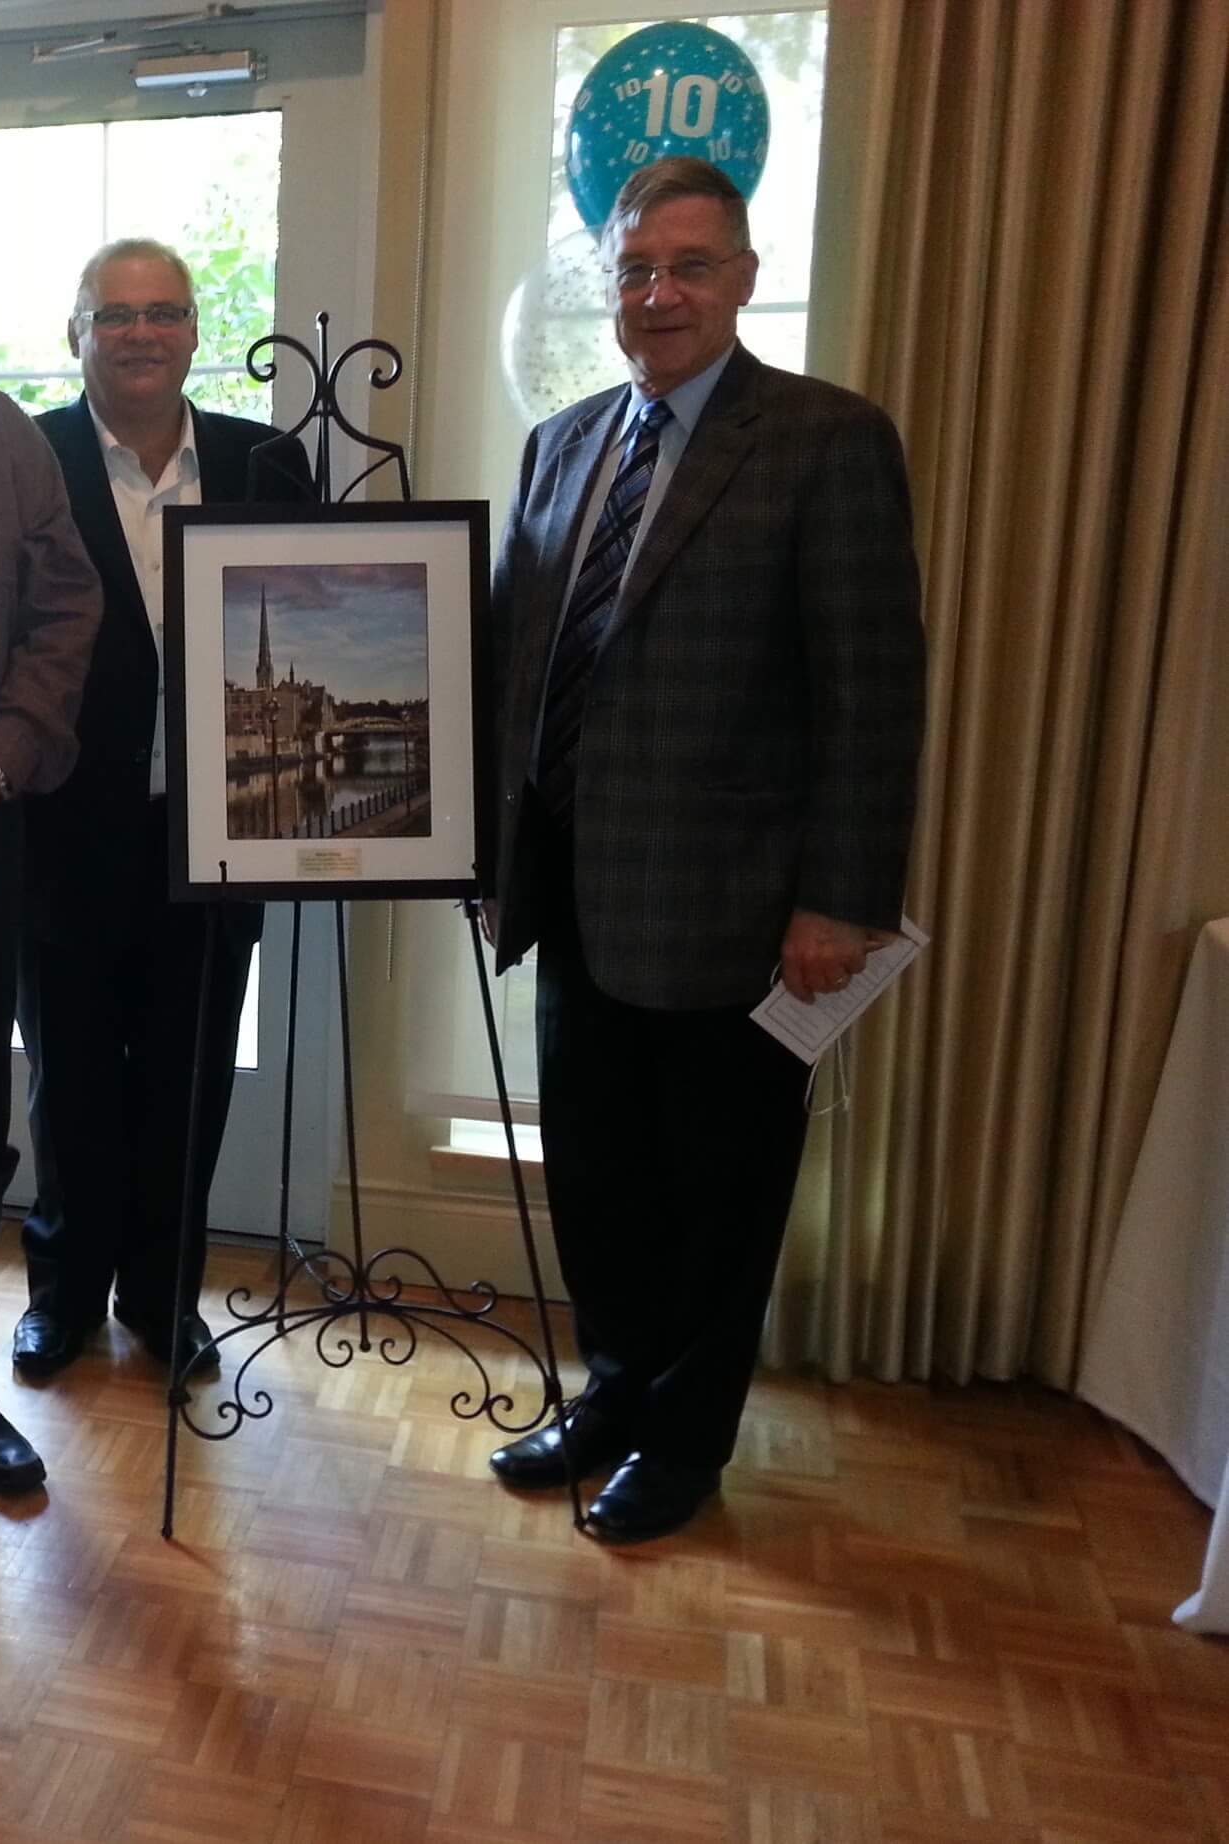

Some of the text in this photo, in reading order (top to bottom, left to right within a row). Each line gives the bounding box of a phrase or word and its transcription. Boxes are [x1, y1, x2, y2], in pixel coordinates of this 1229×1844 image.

[614, 78, 642, 101] 10
[719, 69, 743, 93] 10
[642, 73, 718, 138] 10
[624, 139, 649, 164] 10
[707, 139, 730, 161] 10
